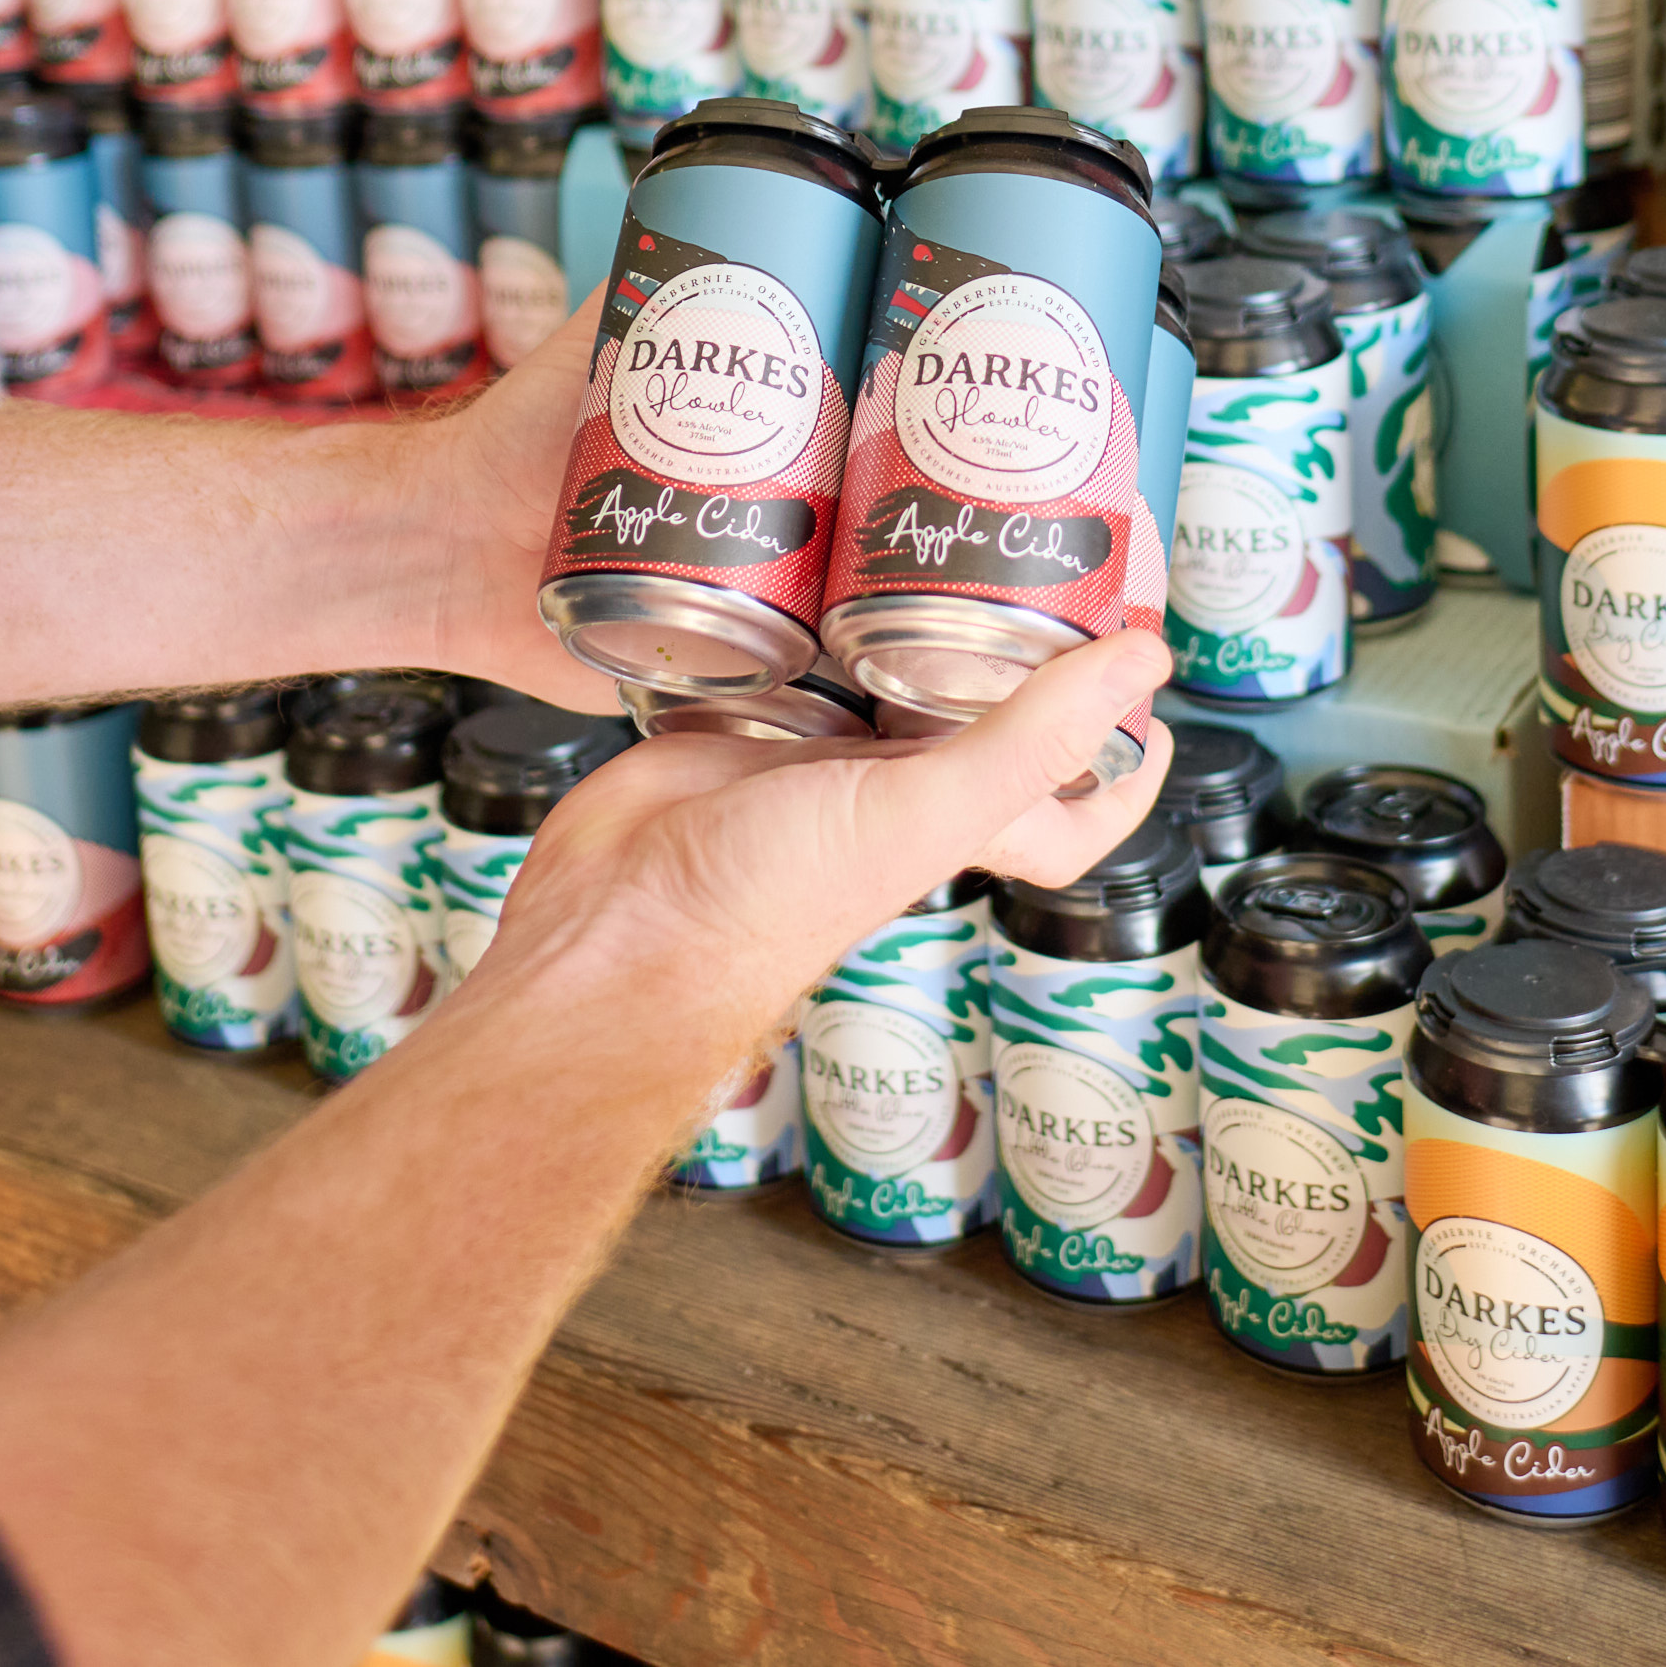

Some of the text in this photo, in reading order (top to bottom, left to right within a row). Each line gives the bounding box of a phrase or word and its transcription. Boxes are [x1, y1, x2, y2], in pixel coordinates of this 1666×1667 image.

[1405, 31, 1533, 57] DARKES
[636, 273, 812, 356] GLENBERNIE ORCHARD
[703, 288, 756, 301] EST.1939
[988, 299, 1043, 314] EST.1939
[918, 285, 1101, 368] GLENBERNIE ORCHARD
[628, 338, 810, 399] DARKES
[914, 352, 1099, 413] DARKES
[645, 372, 776, 426] Howler
[935, 386, 1071, 442] Howler
[628, 432, 674, 467] CRUSHED
[686, 457, 772, 476] AUSTRALIAN
[689, 432, 716, 442] 375ml
[919, 449, 971, 484] CRUSHED
[590, 483, 788, 554] Apple Cider
[884, 501, 1089, 573] Apple Cider
[1175, 523, 1289, 554] ARKES
[1585, 615, 1632, 664] Dry
[1569, 706, 1648, 766] Apple
[809, 1048, 944, 1096] DARKES
[1002, 1088, 1137, 1147] DARKES
[1209, 1144, 1351, 1212] DARKES
[1517, 1242, 1582, 1295] ORCHARD
[1268, 1301, 1356, 1339] Cider
[1424, 1262, 1586, 1336] DARKES
[1437, 1306, 1565, 1370] Dry Cider
[1423, 1406, 1596, 1480] Apple Cider
